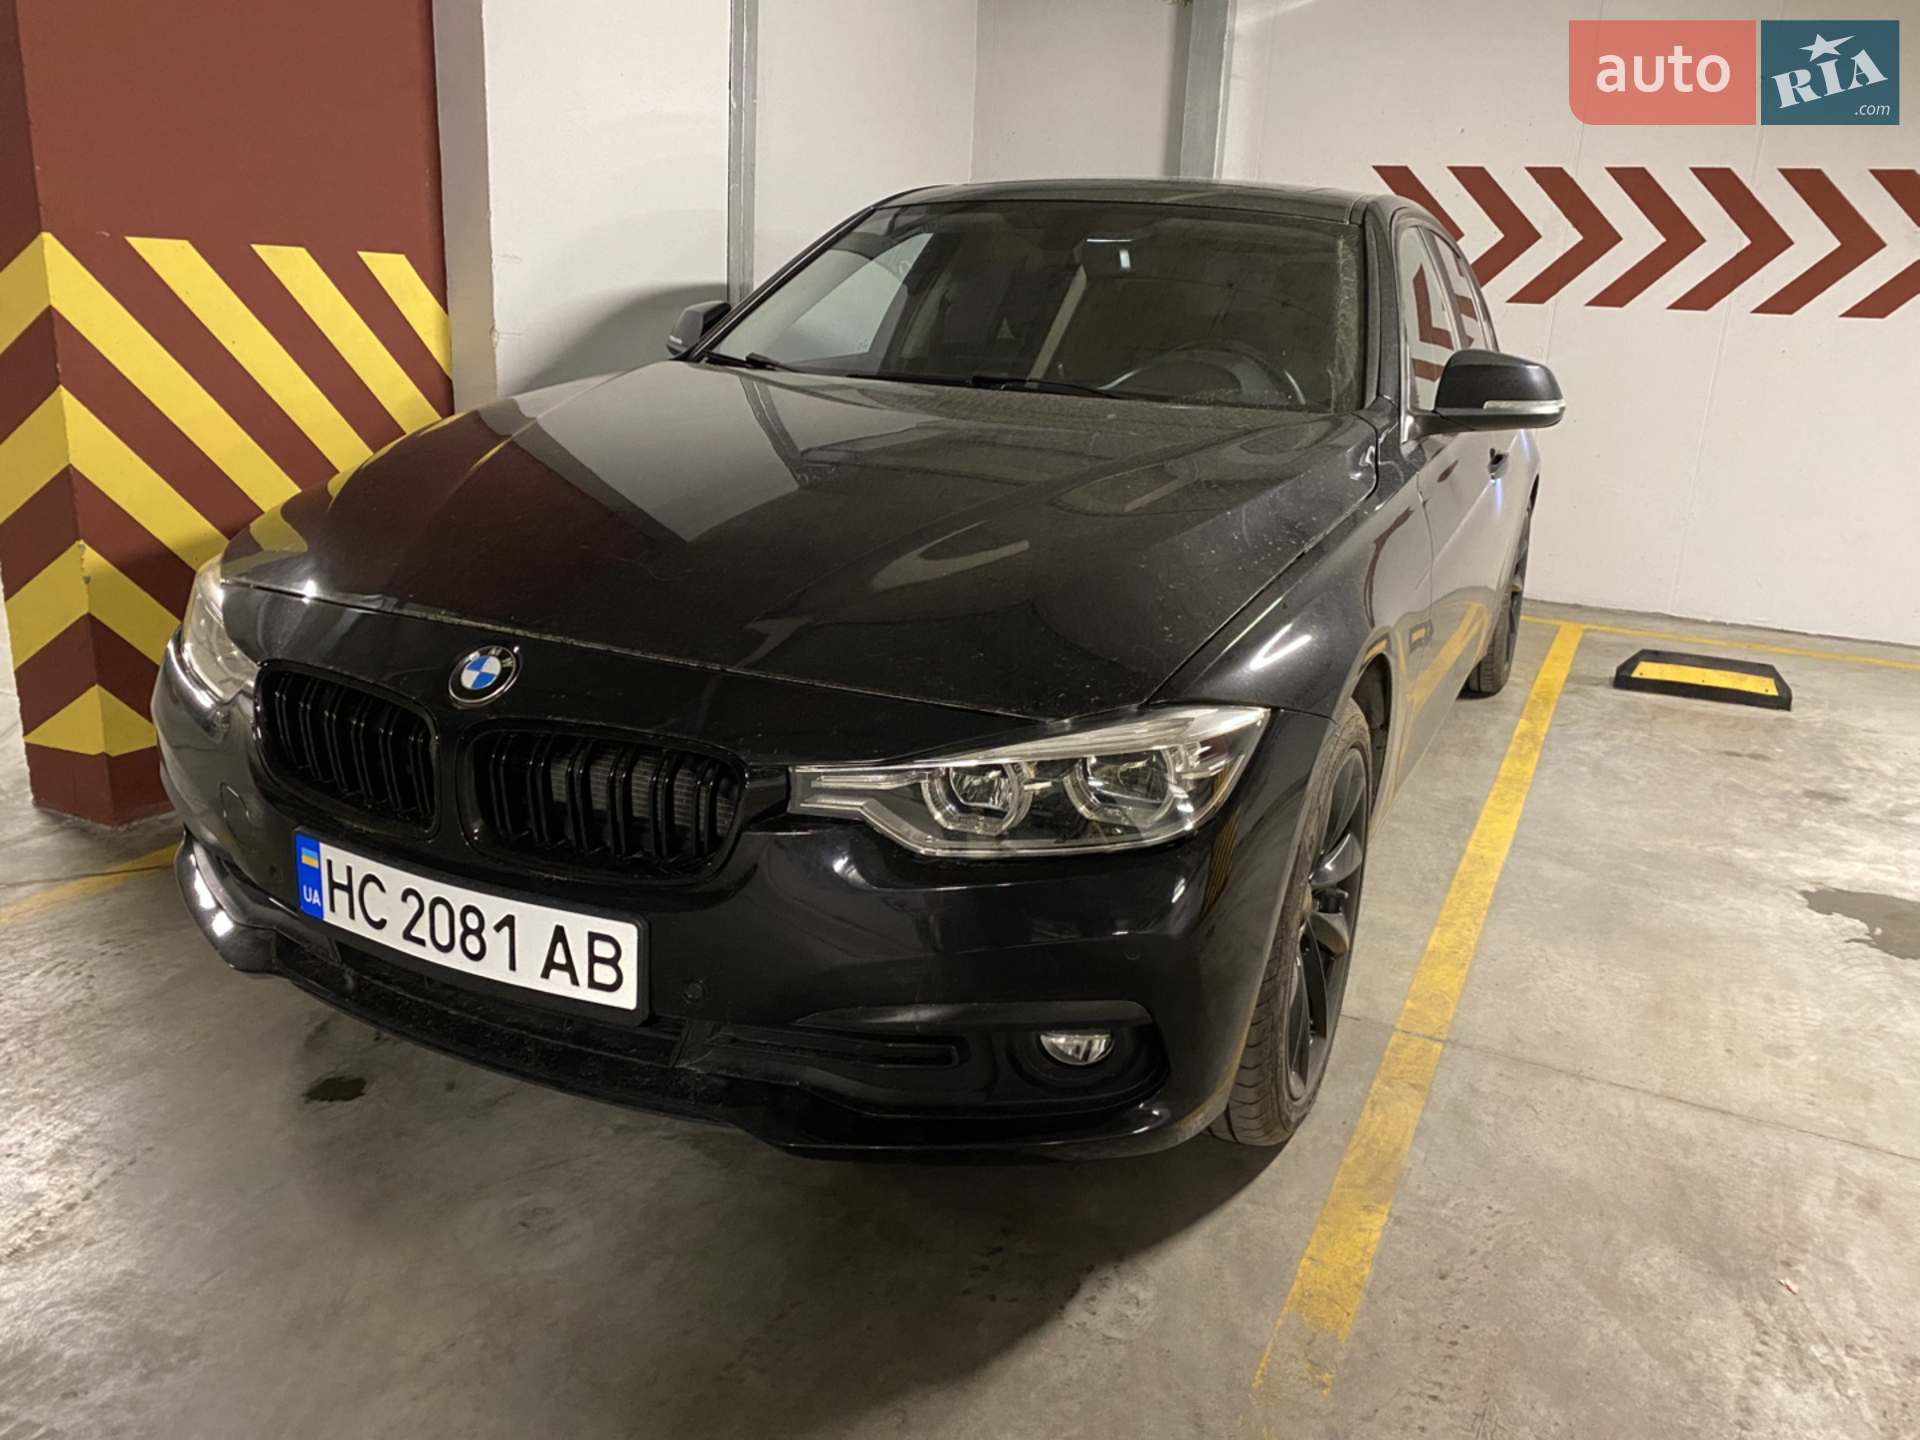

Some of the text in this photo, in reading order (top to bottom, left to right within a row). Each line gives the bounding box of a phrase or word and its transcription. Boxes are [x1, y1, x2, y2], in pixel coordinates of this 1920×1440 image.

[303, 884, 321, 906] UA
[326, 858, 624, 993] HC 2081 AB
